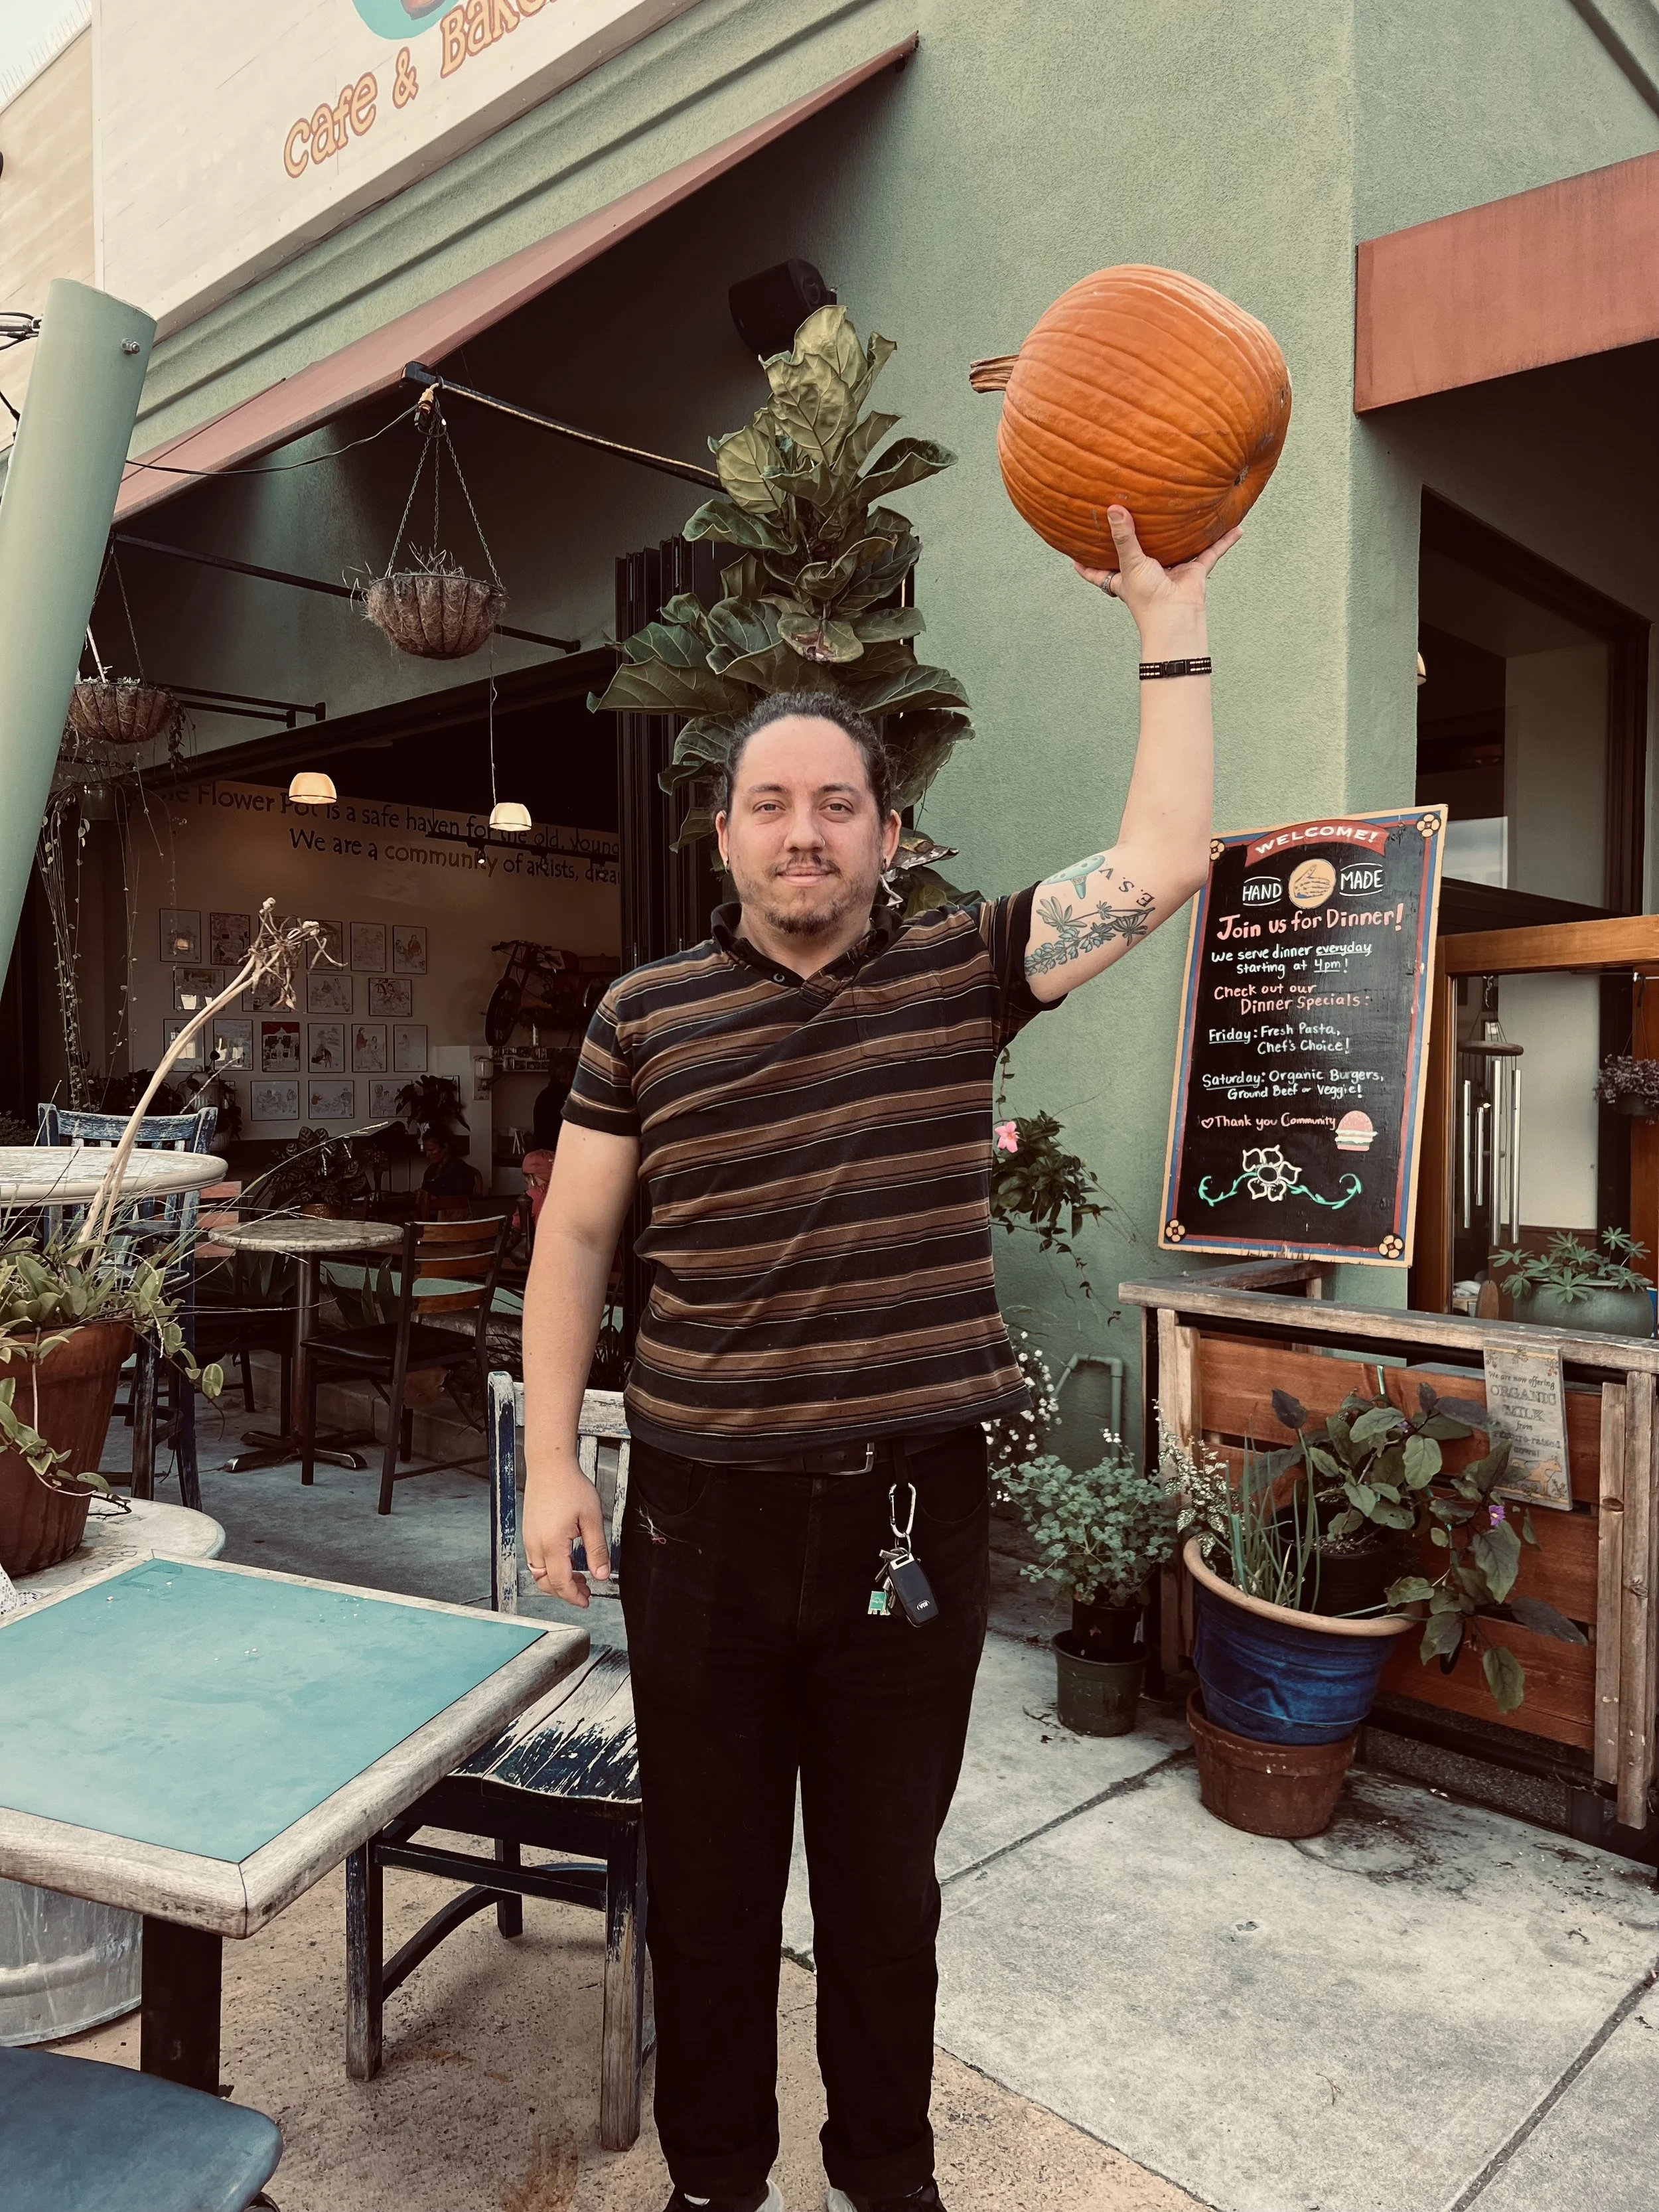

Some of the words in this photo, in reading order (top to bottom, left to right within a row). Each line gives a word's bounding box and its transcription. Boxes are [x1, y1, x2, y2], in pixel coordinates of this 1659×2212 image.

[392, 46, 419, 109] &
[198, 781, 275, 812] Flower
[326, 804, 340, 820] is
[346, 806, 356, 822] a
[362, 804, 399, 828] safe
[406, 807, 459, 835] haven
[466, 815, 496, 840] for
[1254, 826, 1379, 854] WELCOME!
[289, 828, 326, 851] We
[332, 837, 362, 855] are
[368, 843, 378, 860] a
[503, 853, 524, 873] of
[585, 861, 620, 885] drea
[1242, 883, 1283, 901] HAND
[1340, 869, 1384, 890] MADE
[1216, 914, 1261, 940] Join
[1268, 919, 1287, 933] us
[1291, 910, 1322, 931] for
[1327, 903, 1404, 932] Dinner!
[1238, 948, 1269, 960] serve
[1272, 943, 1313, 959] dinner
[1315, 941, 1372, 957] everyday
[1236, 962, 1285, 980] starting
[1293, 960, 1307, 970] at
[1214, 984, 1257, 999] Check
[1261, 984, 1284, 994] out
[1289, 984, 1317, 994] our
[1241, 998, 1293, 1015] Dinner
[1208, 1027, 1258, 1045] Friday:
[1261, 1024, 1294, 1037] Fresh
[1299, 1022, 1340, 1036] Pasta,
[1257, 1039, 1296, 1055] Chef's
[1300, 1037, 1350, 1054] Choice!
[1202, 1071, 1265, 1088] Saturday:
[1269, 1069, 1324, 1084] Organic
[1329, 1069, 1384, 1083] Burgers,
[1228, 1087, 1268, 1100] Ground
[1272, 1084, 1299, 1096] Beef
[1215, 1114, 1251, 1127] Thank
[1256, 1120, 1277, 1131] you
[1280, 1112, 1336, 1131] Community
[1528, 1376, 1555, 1390] offering
[1490, 1384, 1556, 1406] ORGANIC
[1502, 1404, 1545, 1422] MILK
[1515, 1420, 1532, 1431] from
